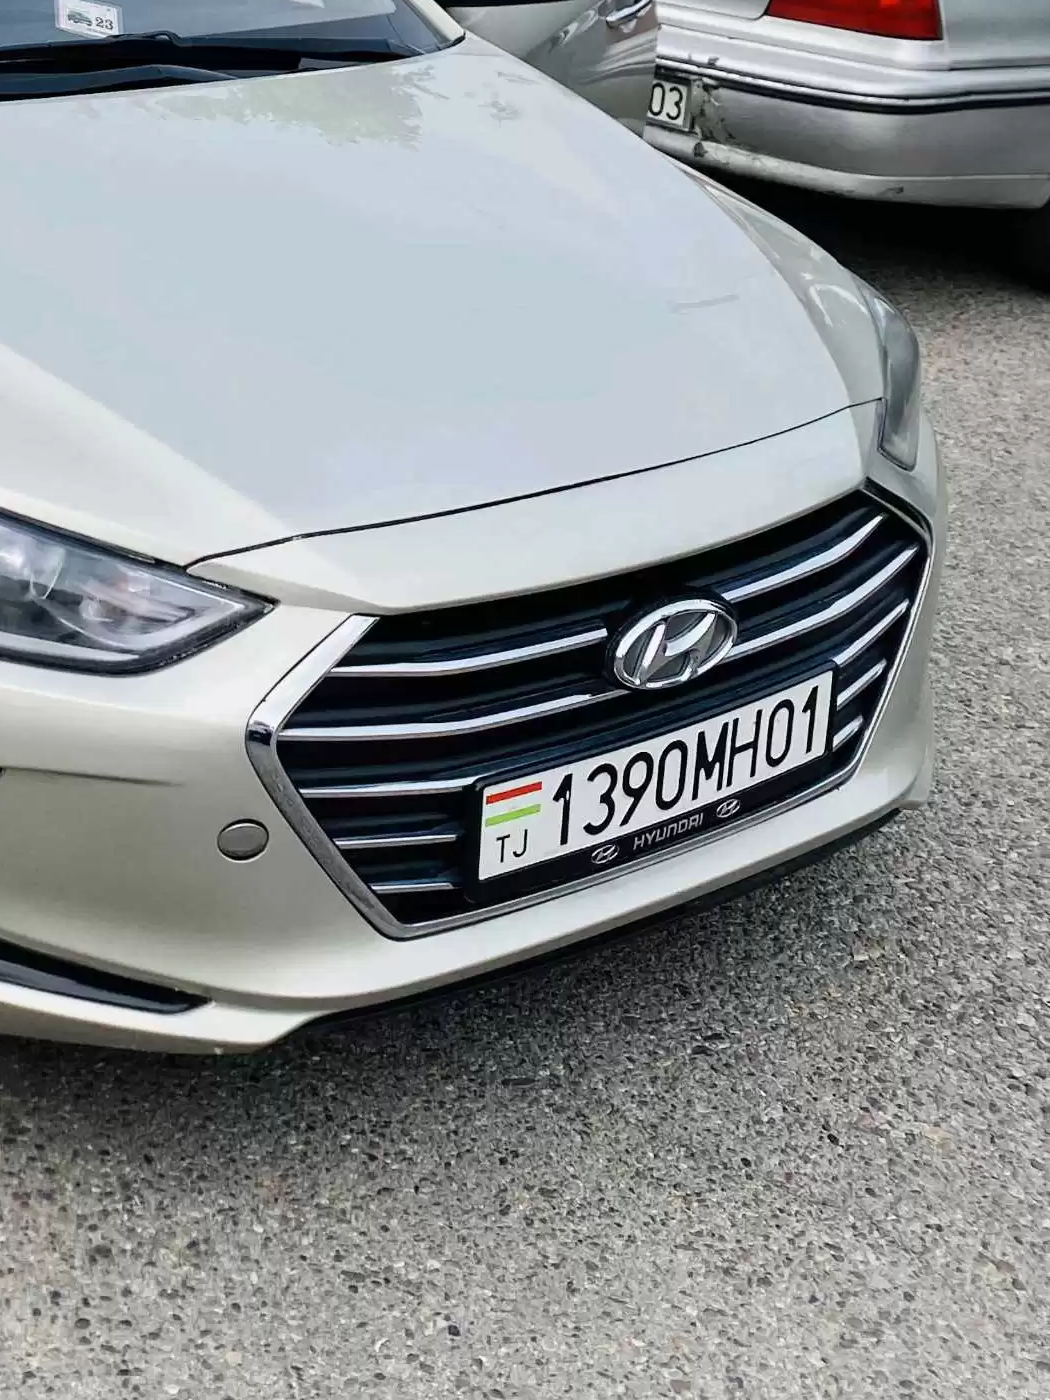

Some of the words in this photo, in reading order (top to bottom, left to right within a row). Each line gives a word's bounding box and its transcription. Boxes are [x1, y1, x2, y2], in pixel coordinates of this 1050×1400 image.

[95, 16, 114, 30] 23
[648, 82, 683, 120] 03
[552, 685, 819, 846] 1390MH01
[496, 829, 528, 863] TJ
[633, 813, 705, 851] HYUNDAI
